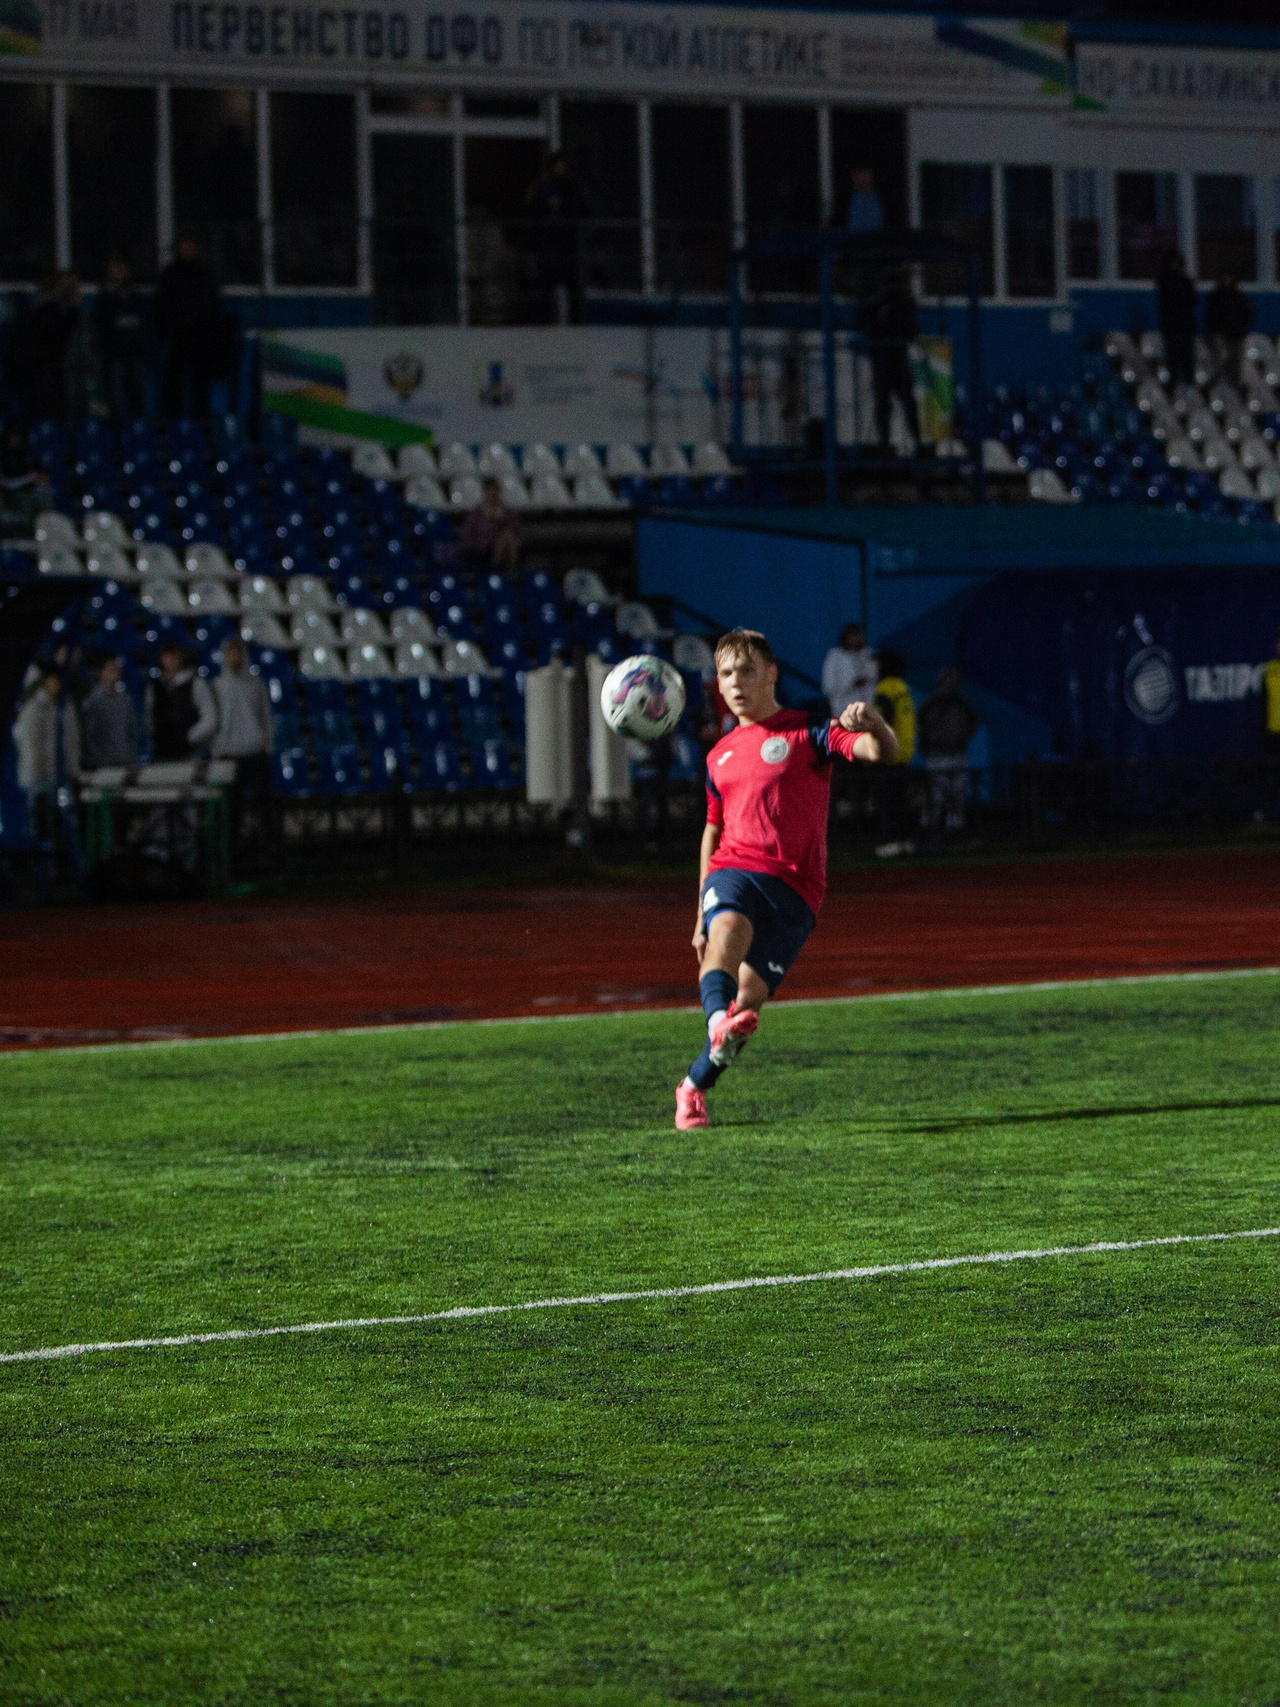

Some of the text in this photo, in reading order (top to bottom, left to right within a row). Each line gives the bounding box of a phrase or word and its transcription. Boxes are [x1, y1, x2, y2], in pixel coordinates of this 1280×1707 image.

[172, 3, 410, 60] ПЕРВЕНСТВО
[425, 13, 502, 64] ДФО
[520, 18, 560, 65] ПО
[687, 26, 828, 78] АТЛЕТИКЕ
